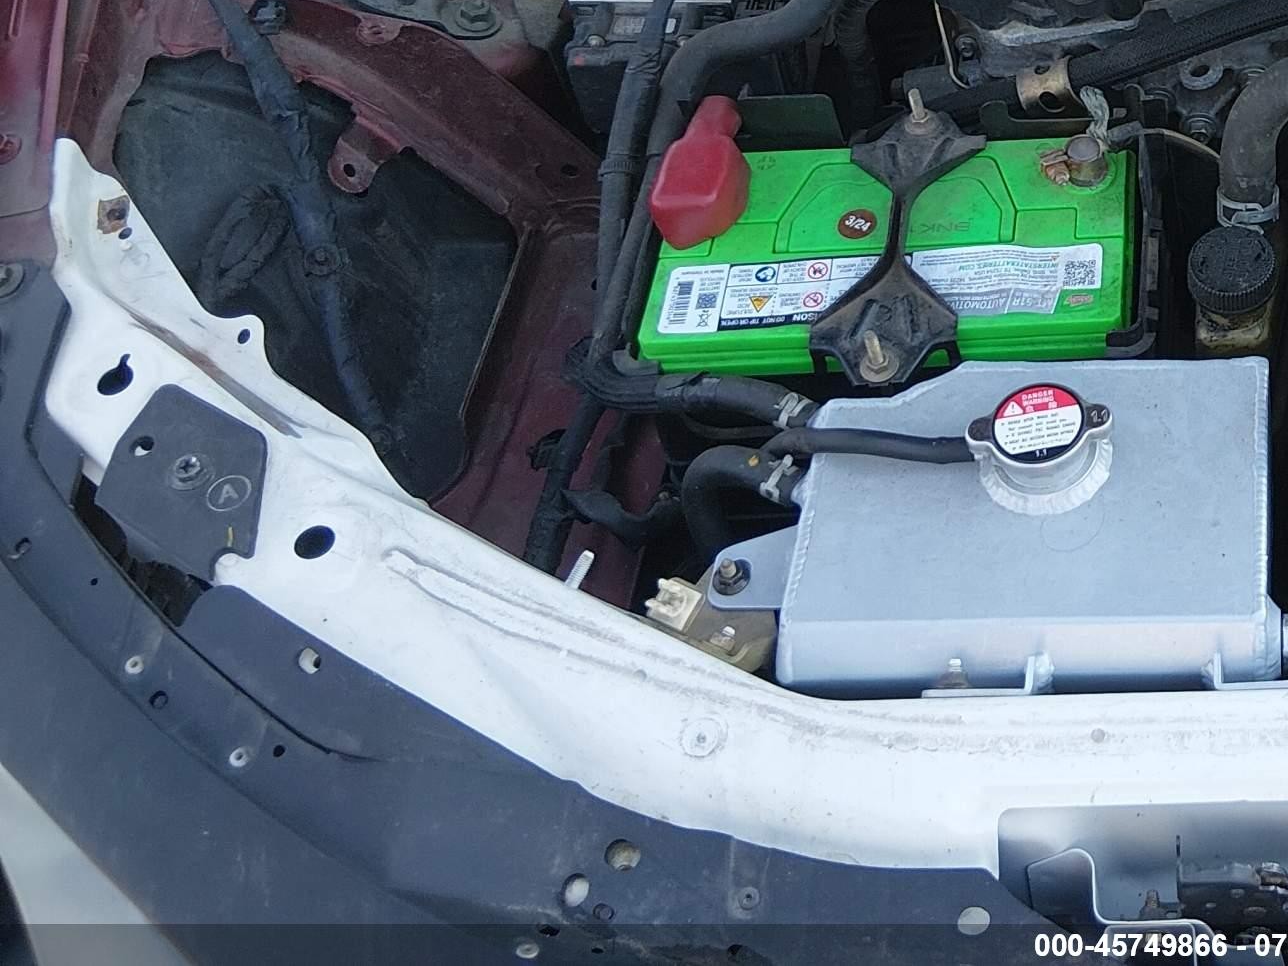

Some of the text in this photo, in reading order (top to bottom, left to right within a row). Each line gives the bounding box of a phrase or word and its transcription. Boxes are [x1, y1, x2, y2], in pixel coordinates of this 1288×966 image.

[844, 215, 872, 232] 3/24
[949, 297, 1006, 310] AUTOMOTIV
[792, 312, 819, 323] ISON
[1021, 389, 1054, 400] DANGER
[1022, 396, 1054, 406] WARNING
[218, 483, 239, 505] A
